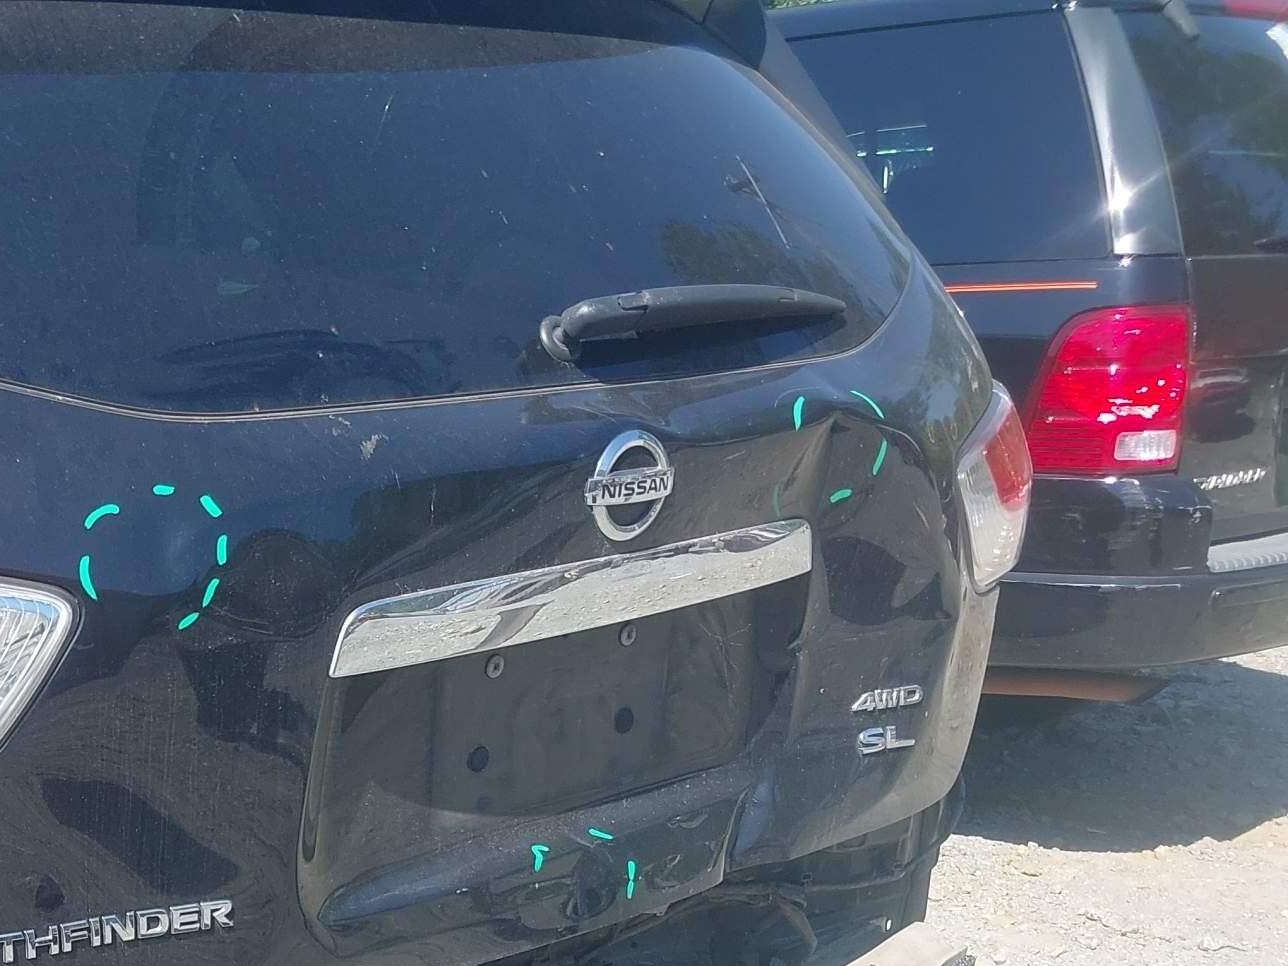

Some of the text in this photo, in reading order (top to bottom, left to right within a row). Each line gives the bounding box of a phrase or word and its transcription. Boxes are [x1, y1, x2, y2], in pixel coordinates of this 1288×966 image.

[601, 476, 670, 499] NISSAN
[851, 684, 923, 711] 4WD
[858, 725, 916, 754] SL
